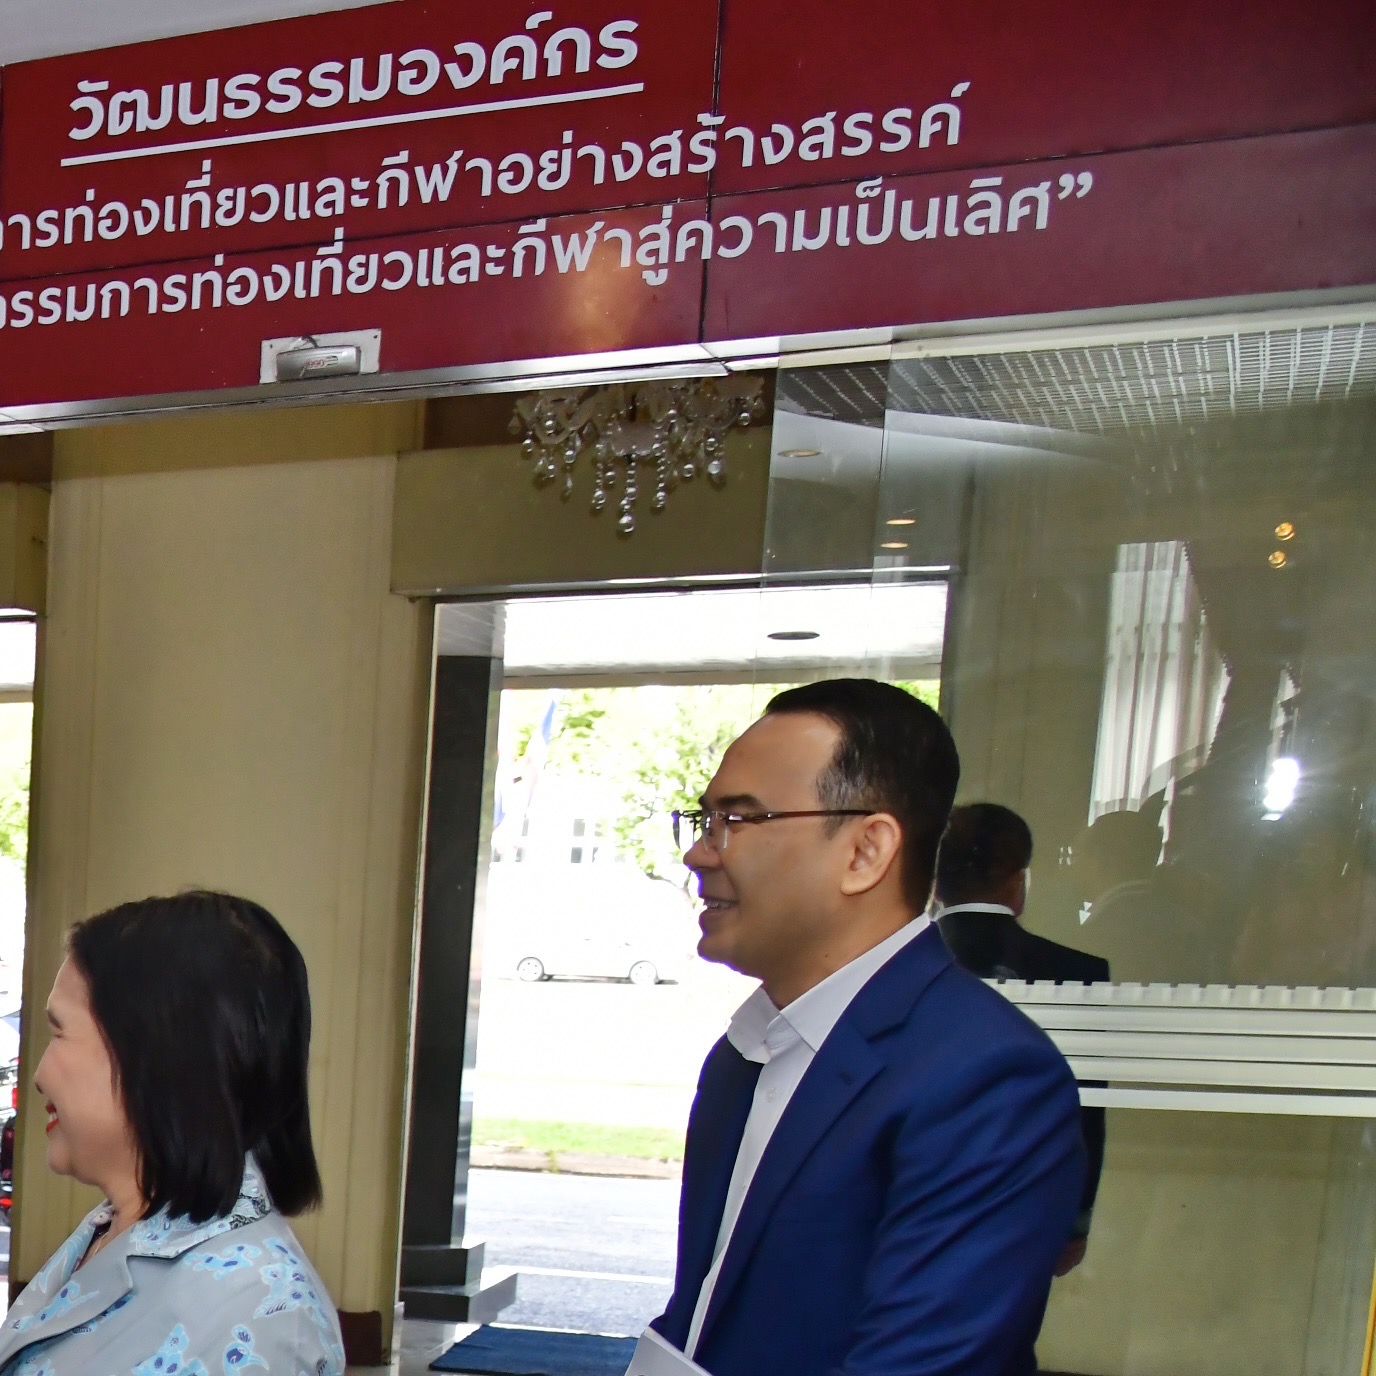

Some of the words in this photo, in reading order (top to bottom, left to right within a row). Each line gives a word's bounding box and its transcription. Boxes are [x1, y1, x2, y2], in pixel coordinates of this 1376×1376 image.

[68, 11, 639, 141] วัฒนธรรมองค์กร
